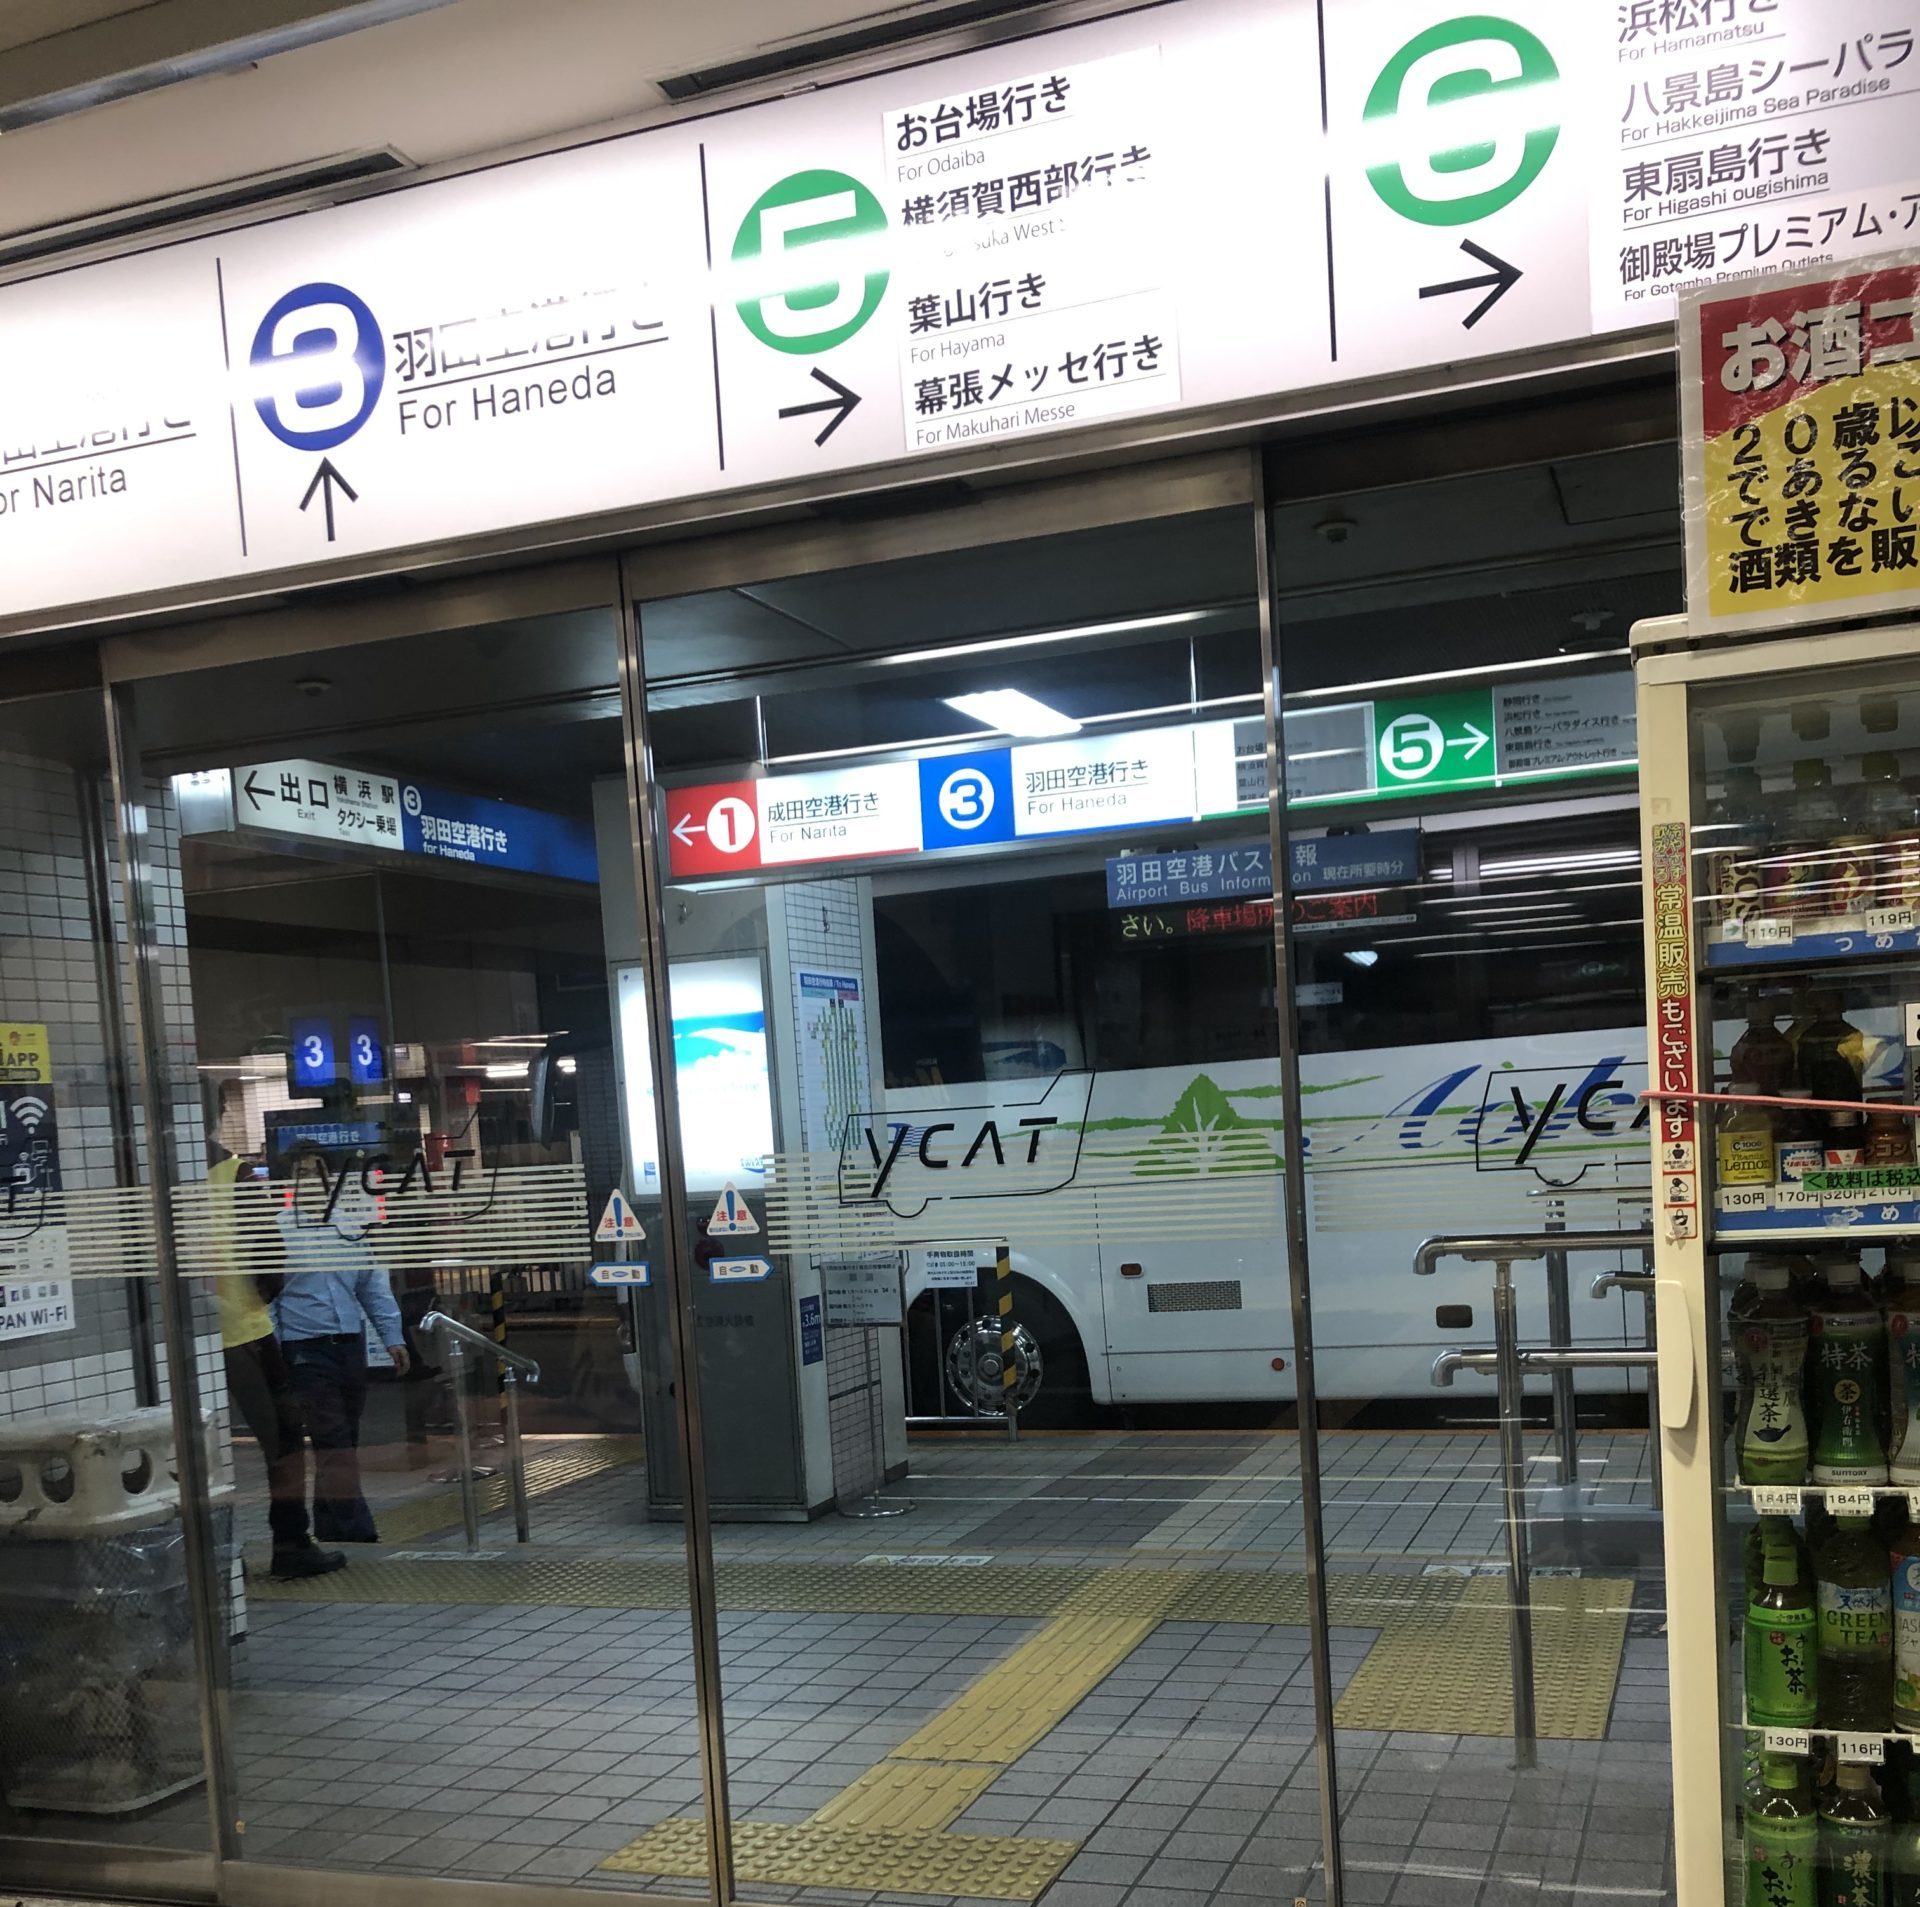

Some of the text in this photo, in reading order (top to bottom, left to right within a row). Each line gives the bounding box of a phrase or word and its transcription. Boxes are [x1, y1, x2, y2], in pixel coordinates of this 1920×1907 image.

[1618, 21, 1765, 63] For Hamamatsu
[1621, 29, 1914, 123] 八景島シーパラ
[896, 75, 1071, 151] お台場行き
[1396, 38, 1527, 203] 6
[1621, 77, 1891, 143] For Hakkeijima Sea Paradise
[897, 147, 986, 182] For Odaiba
[1622, 128, 1831, 204] 東扇島行き
[1622, 171, 1829, 223] For Higashi ougishima
[759, 190, 866, 338] 5
[1624, 288, 1645, 301] For
[1716, 264, 1777, 281] Premium
[908, 272, 1047, 335] 葉山行き
[910, 332, 1006, 364] For Hayama
[270, 302, 366, 433] 3
[914, 333, 1163, 416] 幕張メッセ行き
[399, 364, 617, 435] For Haneda
[916, 402, 1076, 447] For Makuhari Messe
[33, 465, 126, 508] Narita
[1729, 525, 1918, 594] 酒類を販
[1392, 722, 1433, 770] 5
[280, 772, 330, 809] 出口
[333, 775, 396, 805] 横浜駅
[1025, 758, 1149, 793] 羽田空港行き
[297, 809, 316, 821] Exit
[767, 792, 880, 823] 成田空港行き
[948, 777, 985, 823] 3
[1027, 792, 1127, 816] For Haneda
[336, 808, 397, 836] タクシー乗場
[420, 814, 508, 854] 羽田空港行き
[769, 822, 847, 844] For Narita
[422, 840, 476, 861] for Haneda
[1116, 844, 1318, 885] 羽田空港バス報
[1116, 871, 1312, 901] Airport Bus Informon
[1750, 926, 1791, 938] 119円
[1869, 911, 1911, 926] 119円
[1835, 933, 1920, 952] つめ
[304, 1035, 324, 1068] 3
[356, 1033, 373, 1066] 3
[865, 1116, 1058, 1198] YCAT
[1724, 1158, 1771, 1172] Lemon
[316, 1148, 476, 1223] YCAT
[1724, 1192, 1765, 1205] 130円
[1778, 1191, 1819, 1202] 170円
[604, 1216, 634, 1229] 注意
[716, 1210, 747, 1222] 注意
[31, 1305, 67, 1325] Wi-Fi
[1820, 1342, 1873, 1371] 特茶
[1757, 1493, 1797, 1504] 184円
[1829, 1493, 1870, 1505] 184円
[1826, 1610, 1888, 1628] GREEN
[1839, 1629, 1879, 1645] TEA
[1779, 1644, 1806, 1695] お茶
[1767, 1735, 1807, 1748] 130円
[1841, 1743, 1882, 1756] 116円
